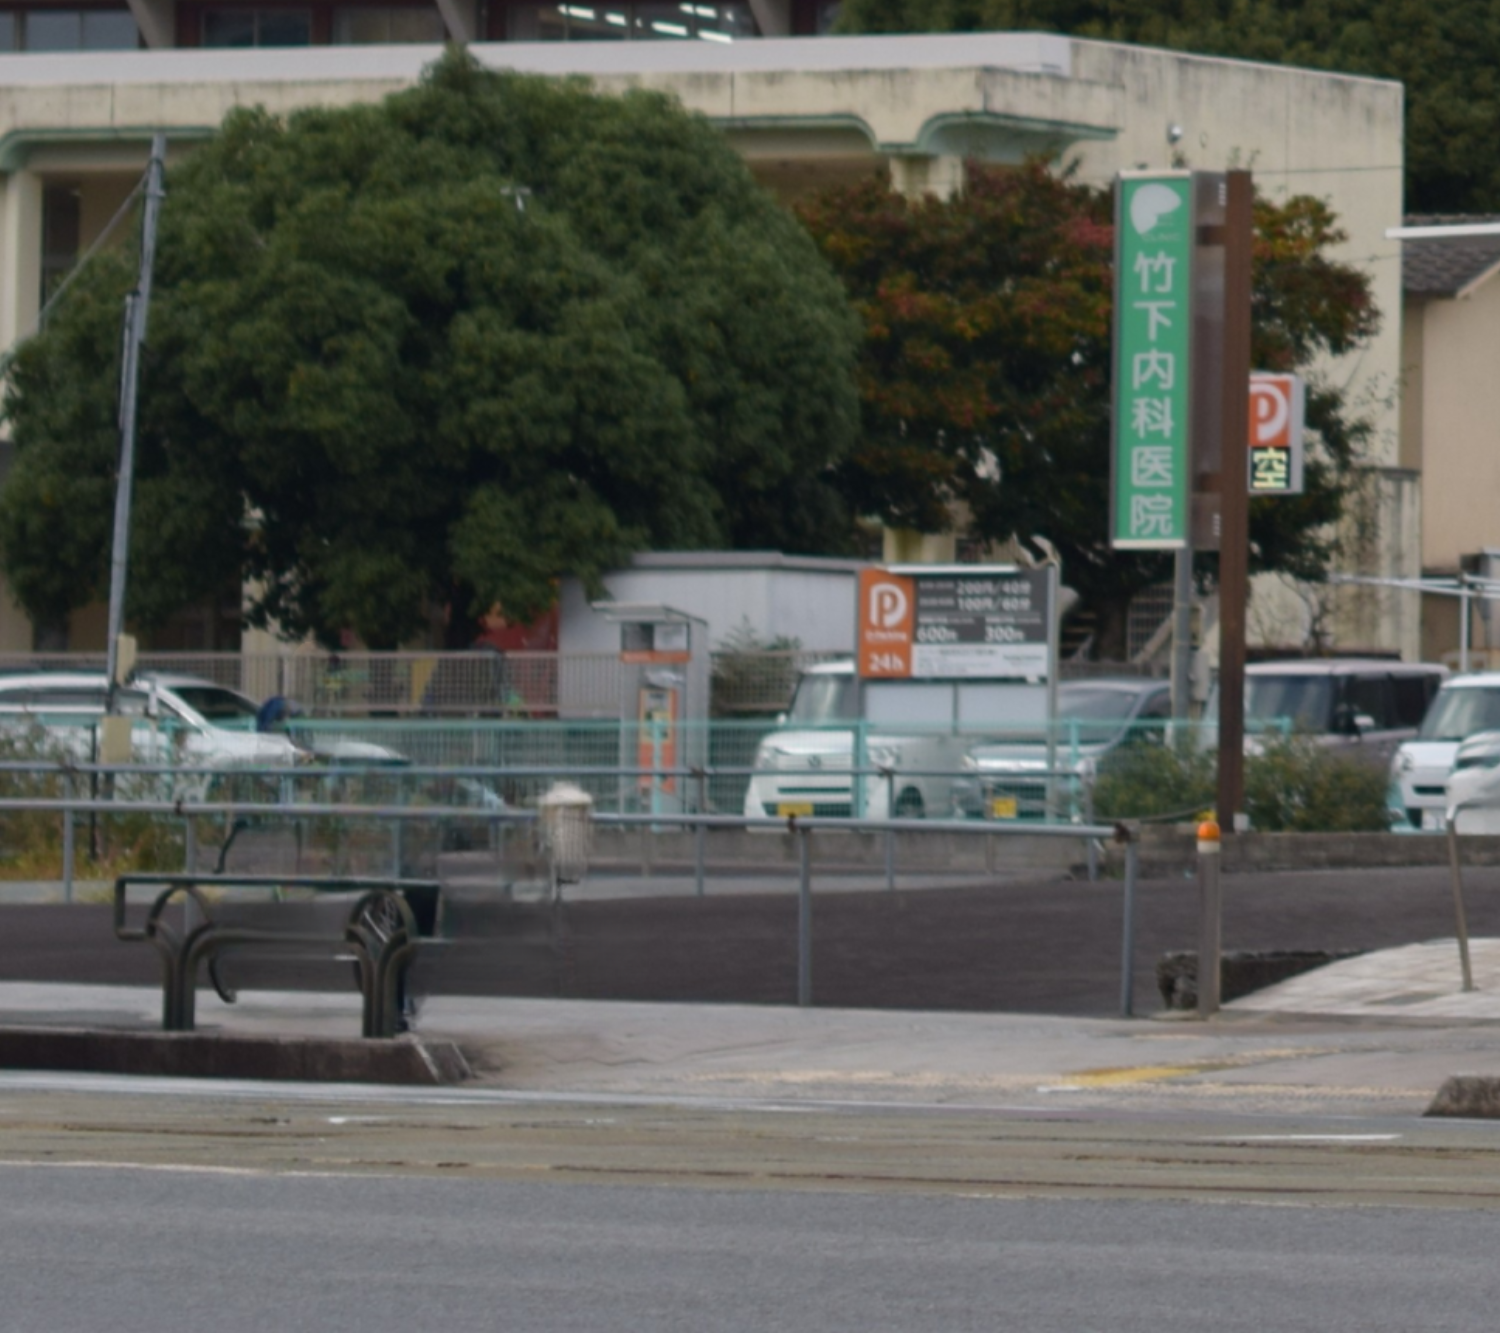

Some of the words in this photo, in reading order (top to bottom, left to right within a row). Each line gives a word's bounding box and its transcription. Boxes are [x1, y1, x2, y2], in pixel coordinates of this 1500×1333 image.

[1130, 251, 1177, 537] 竹下内科医院
[1252, 446, 1288, 489] 空
[869, 582, 908, 628] P
[868, 652, 905, 672] 24h
